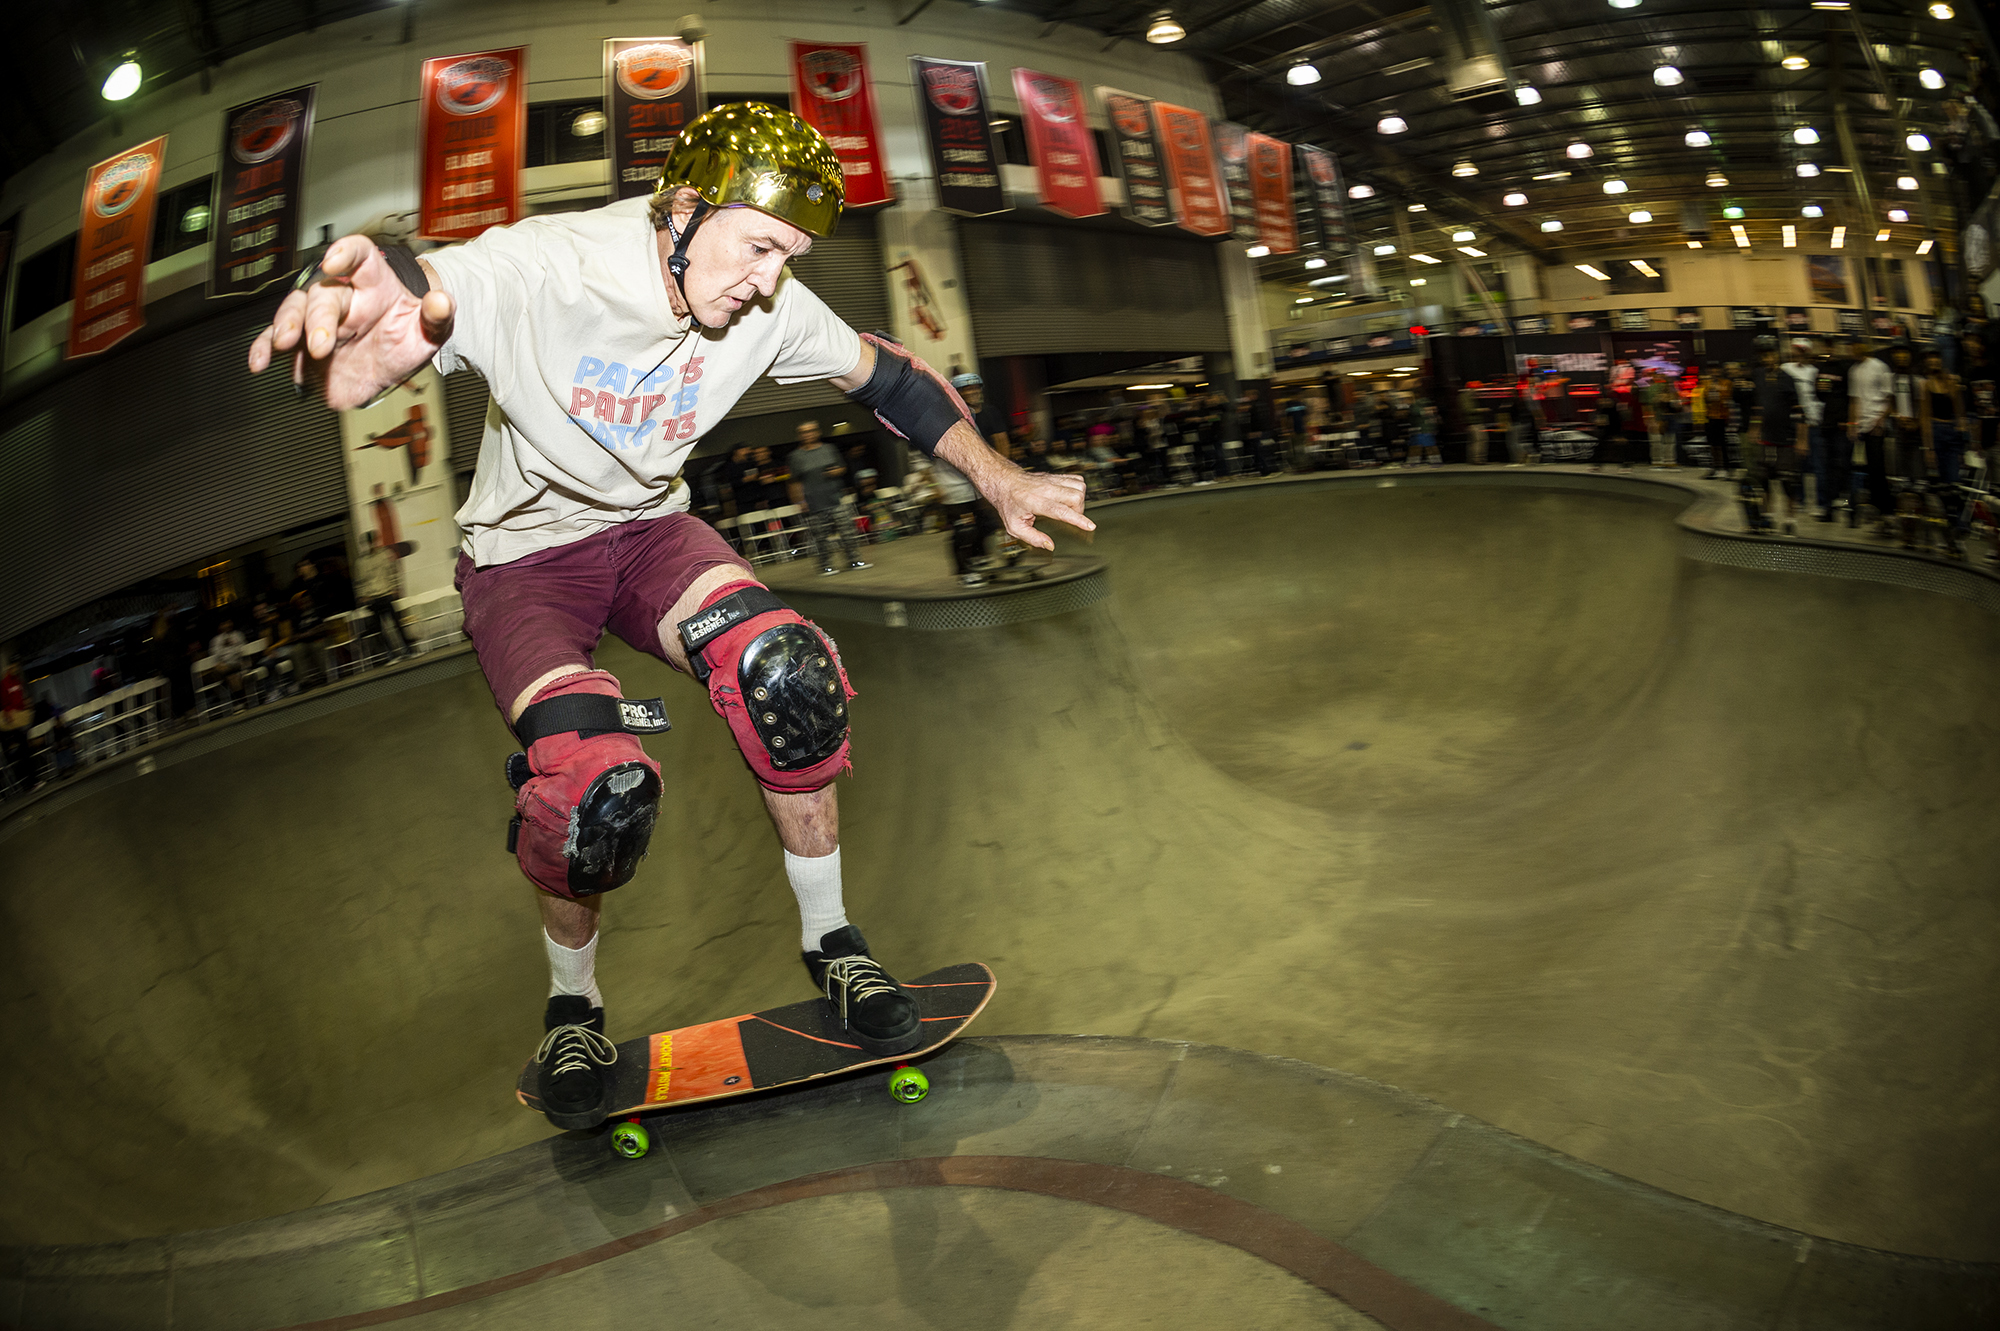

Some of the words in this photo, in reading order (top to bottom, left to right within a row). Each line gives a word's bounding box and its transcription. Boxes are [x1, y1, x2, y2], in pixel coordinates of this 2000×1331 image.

[572, 355, 675, 395] PATP
[568, 386, 667, 425] PATP
[670, 383, 700, 417] 13
[661, 410, 697, 441] 13
[620, 703, 653, 718] PRO-
[659, 1035, 673, 1068] POCKET
[654, 1071, 671, 1101] PISTOLS
